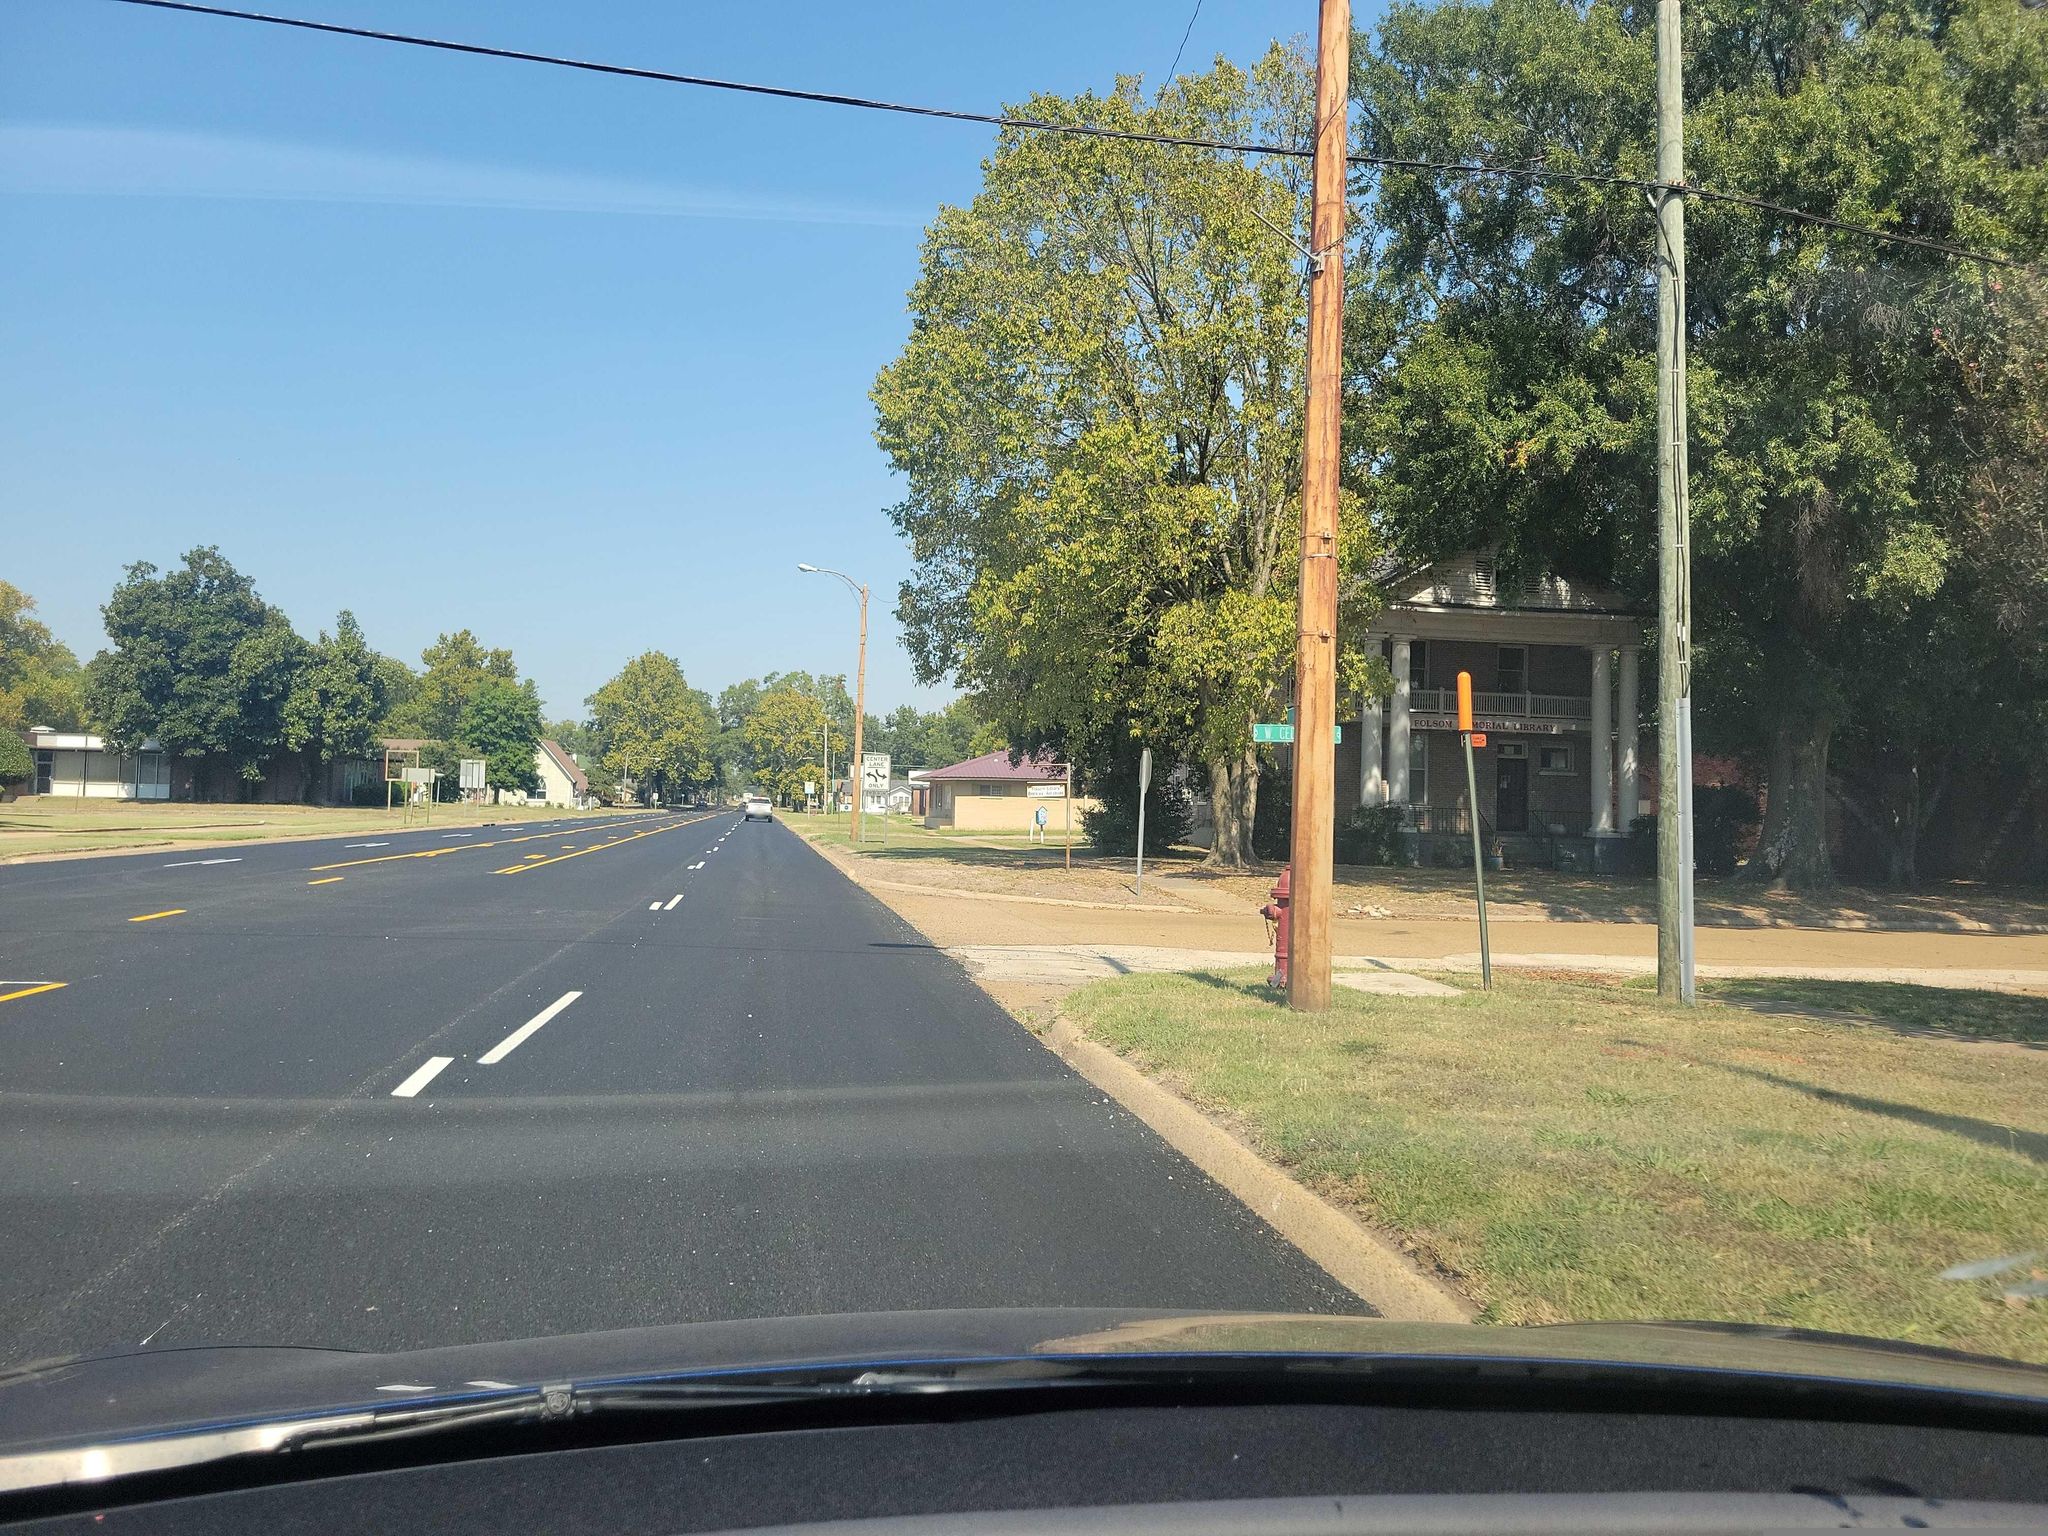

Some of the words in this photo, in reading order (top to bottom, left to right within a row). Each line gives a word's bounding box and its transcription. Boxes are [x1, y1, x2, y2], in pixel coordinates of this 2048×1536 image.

[1414, 719, 1453, 728] FOLSOM
[1472, 721, 1509, 730] MORIAL
[1513, 723, 1555, 732] LIBRARY
